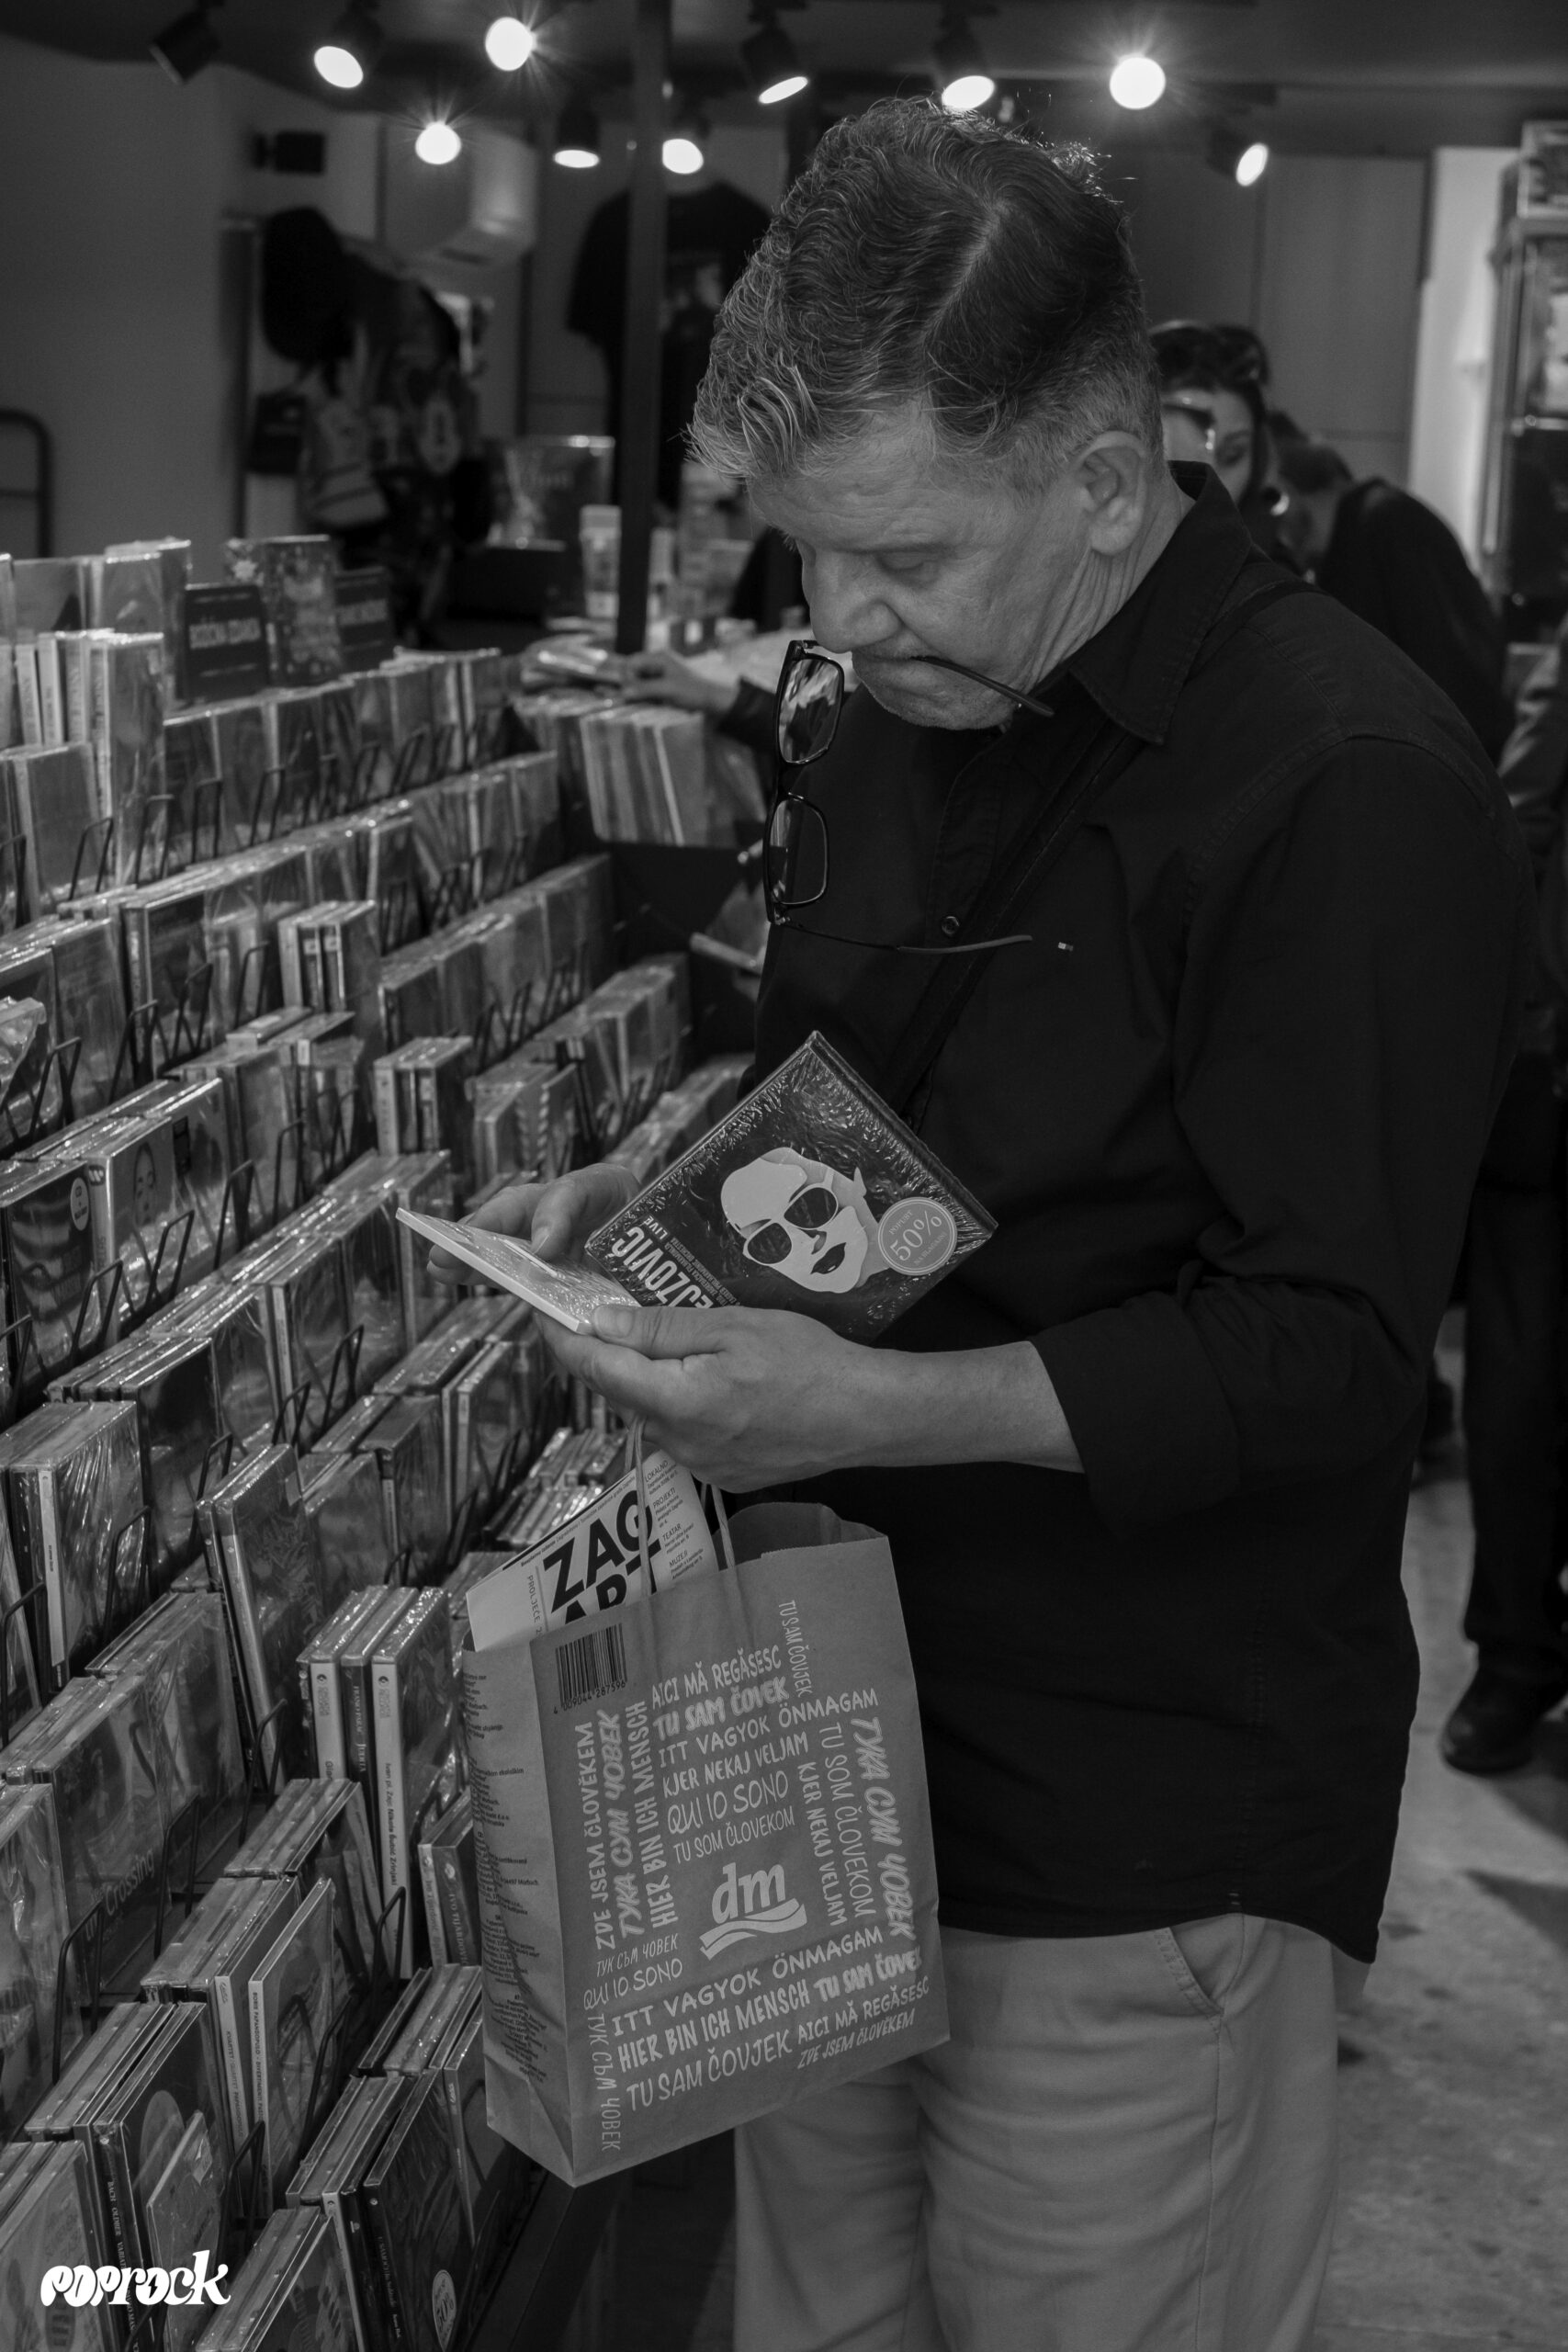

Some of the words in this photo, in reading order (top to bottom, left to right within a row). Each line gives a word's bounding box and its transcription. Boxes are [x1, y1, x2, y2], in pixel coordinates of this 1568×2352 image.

[642, 1214, 670, 1241] LIVE
[889, 1211, 943, 1262] 50%
[644, 1459, 669, 1483] LOKALNO
[652, 1487, 676, 1510] PROJEKTI
[542, 1489, 653, 1614] ZAG
[662, 1523, 682, 1543] TEATAR
[778, 1600, 799, 1617] TU
[782, 1617, 803, 1645] SAM
[596, 1679, 626, 1699] 287596
[651, 1676, 681, 1711] AICI
[683, 1661, 708, 1698] MĂ
[711, 1645, 782, 1690] REGĂSESC
[787, 1645, 813, 1698] ČOVJEK
[652, 1711, 681, 1741] TU
[684, 1696, 726, 1732] SAM
[730, 1676, 790, 1716] ČOVEK
[658, 1740, 689, 1769] ITT
[695, 1714, 771, 1755] VAGYOK
[778, 1688, 879, 1728] ÖNMAGAM
[818, 1722, 845, 1749] TU
[596, 1709, 626, 1801] ЧОВЕК
[625, 1701, 655, 1794] MENSCH
[662, 1767, 700, 1799] KJER
[704, 1751, 751, 1785] NEKAJ
[754, 1731, 808, 1768] VELJAM
[824, 1754, 855, 1802] SOM
[850, 1716, 891, 1781] ТУКА
[574, 1721, 604, 1838] ČLOVĚKEM
[667, 1796, 704, 1835] QUI
[706, 1791, 728, 1822] IO
[733, 1770, 788, 1814] SONO
[797, 1761, 823, 1805] KJER
[605, 1807, 634, 1868] СУМ
[634, 1796, 660, 1834] ICH
[672, 1840, 692, 1864] TU
[694, 1830, 724, 1859] SOM
[725, 1804, 795, 1848] ČLOVEKOM
[806, 1807, 834, 1858] NEKAJ
[863, 1786, 903, 1847] СУМ
[103, 1849, 156, 1917] Crossing
[585, 1842, 609, 1903] JSEM
[638, 1834, 667, 1875] BIN
[834, 1804, 876, 1918] ČLOVEKOM
[448, 1893, 458, 1911] IVO
[613, 1871, 645, 1939] ТУКА
[645, 1874, 679, 1928] HIER
[710, 1861, 788, 1924] dm
[818, 1860, 848, 1927] VELJAM
[876, 1852, 917, 1940] ЧОВЕК
[593, 1908, 616, 1951] ZDE
[596, 1956, 614, 1977] ТУК
[616, 1946, 639, 1970] СЪМ
[642, 1933, 680, 1960] ЧОВЕК
[583, 1983, 610, 2011] QUI
[613, 1976, 629, 1999] IO
[633, 1958, 683, 1991] SONO
[612, 2005, 654, 2037] ITT
[663, 1967, 761, 2018] VAGYOK
[772, 1925, 884, 1979] ÖNMAGAM
[797, 2016, 830, 2045] AICI
[835, 1999, 859, 2031] MĂ
[863, 1975, 931, 2021] REGĂSESC
[813, 1975, 840, 2002] TU
[842, 1962, 874, 1995] SAM
[617, 2033, 663, 2074] HIER
[665, 2019, 699, 2055] BIN
[700, 2007, 731, 2042] ICH
[735, 1978, 811, 2031] MENSCH
[796, 2044, 822, 2070] ZDE
[822, 2031, 855, 2059] JSEM
[856, 2007, 916, 2047] ČLOVĚKEM
[587, 2013, 610, 2046] ТУК
[600, 2097, 622, 2152] ЧОВЕК
[626, 2077, 654, 2111] TU
[658, 2060, 704, 2101] SAM
[707, 2029, 793, 2083] ČOVJEK
[107, 2181, 117, 2202] BACH
